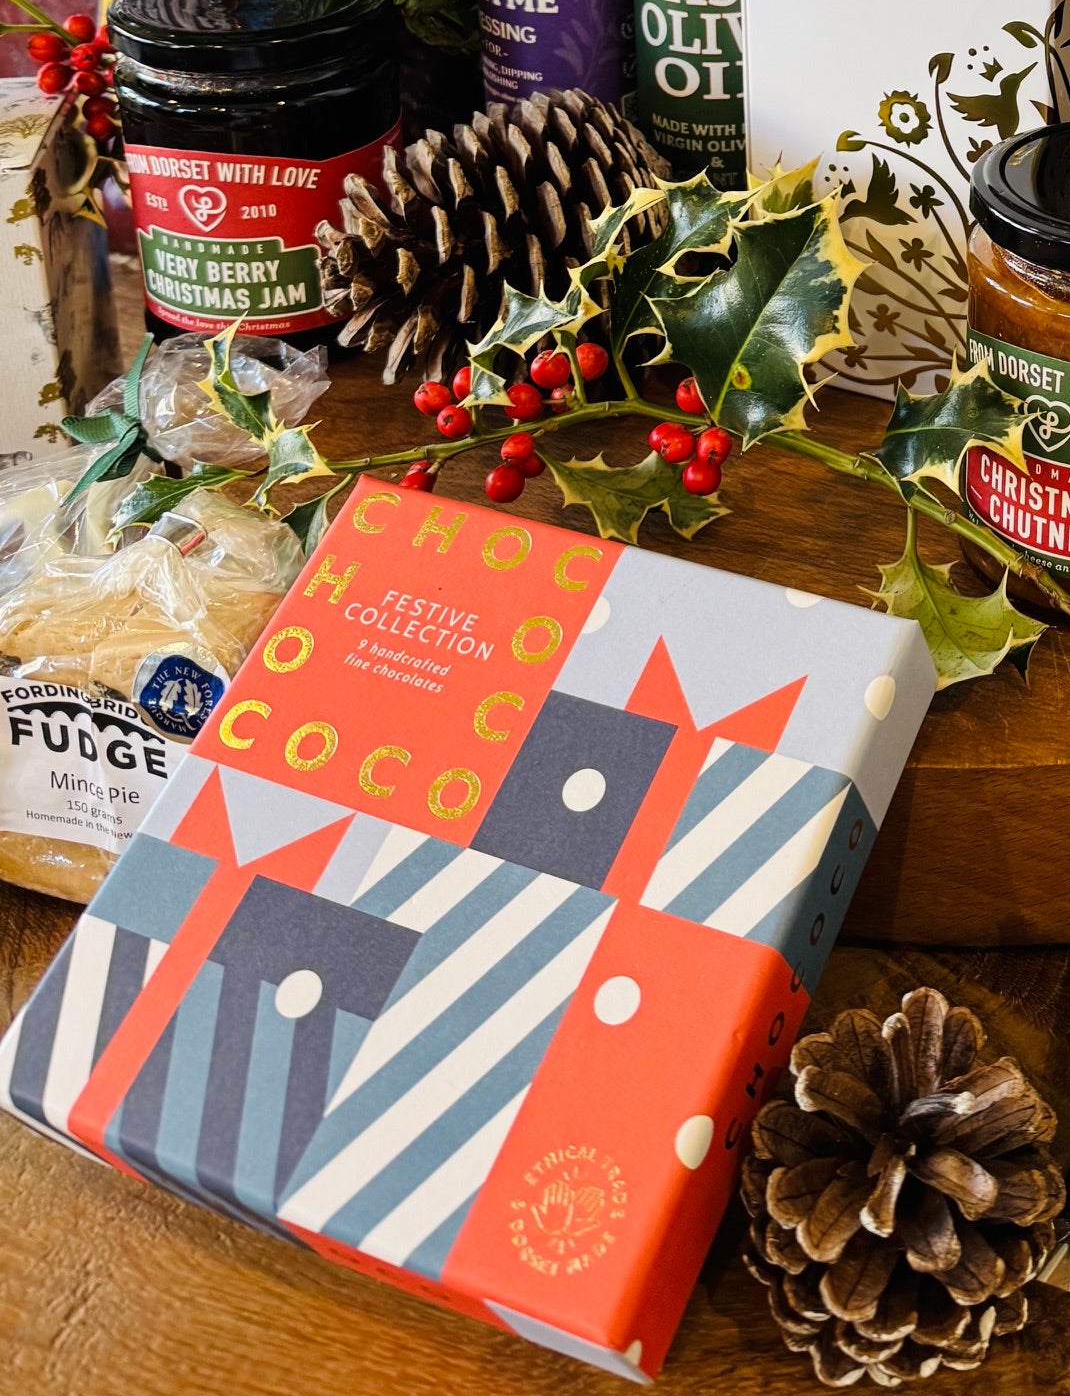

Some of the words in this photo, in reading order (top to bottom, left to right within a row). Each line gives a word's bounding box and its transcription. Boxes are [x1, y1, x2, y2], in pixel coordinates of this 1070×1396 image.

[501, 64, 543, 83] DIPPING
[652, 113, 690, 135] MADE
[692, 123, 736, 137] WITH
[654, 128, 703, 152] VIRGIN
[150, 155, 211, 181] DORSET
[216, 162, 266, 186] WITH
[271, 165, 322, 190] LOVE
[710, 156, 725, 169] &
[241, 204, 277, 220] 2010
[161, 234, 264, 255] HANDMADE
[155, 249, 198, 281] VERY
[207, 259, 280, 285] BERRY
[147, 268, 251, 311] CHRISTMAS
[260, 281, 307, 310] JAM
[238, 319, 291, 332] Christmas
[968, 337, 994, 372] FROM
[997, 350, 1064, 395] DORSET
[380, 589, 480, 633] FESTIVE
[343, 602, 496, 662] COLLECTION
[343, 652, 371, 673] fine
[372, 662, 444, 695] chocolates
[369, 643, 452, 677] handcrafted
[153, 670, 170, 690] THE
[174, 665, 202, 681] NEW
[8, 716, 169, 780] FUDGE
[50, 770, 104, 801] Mince
[109, 786, 141, 805] Pie
[26, 810, 84, 827] Homemade
[95, 821, 110, 834] the
[111, 829, 134, 840] New
[66, 799, 88, 814] 150
[91, 806, 123, 825] grams
